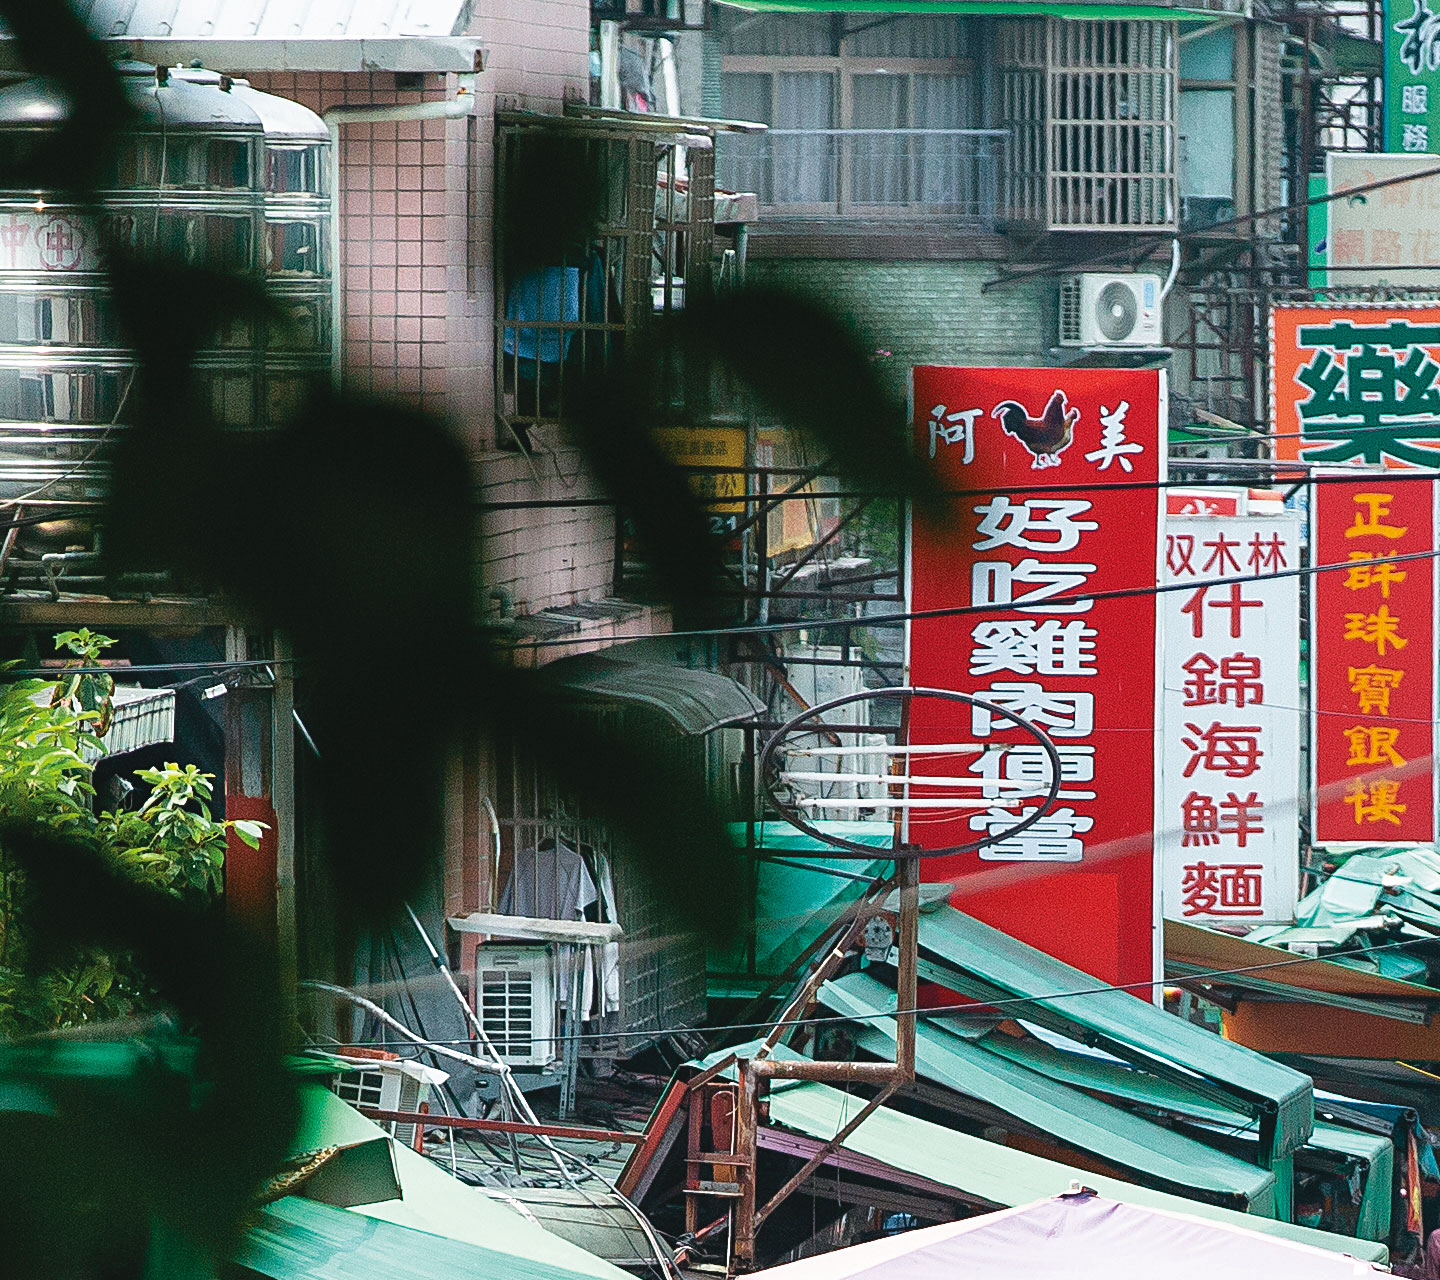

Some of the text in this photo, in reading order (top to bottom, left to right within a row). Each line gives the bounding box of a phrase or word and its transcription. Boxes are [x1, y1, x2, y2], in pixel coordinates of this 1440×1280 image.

[968, 496, 1100, 864] 好吃雞肉便當
[1181, 581, 1265, 918] 什錦海鮮麵
[1344, 493, 1409, 826] 正群珠寶銀樓
